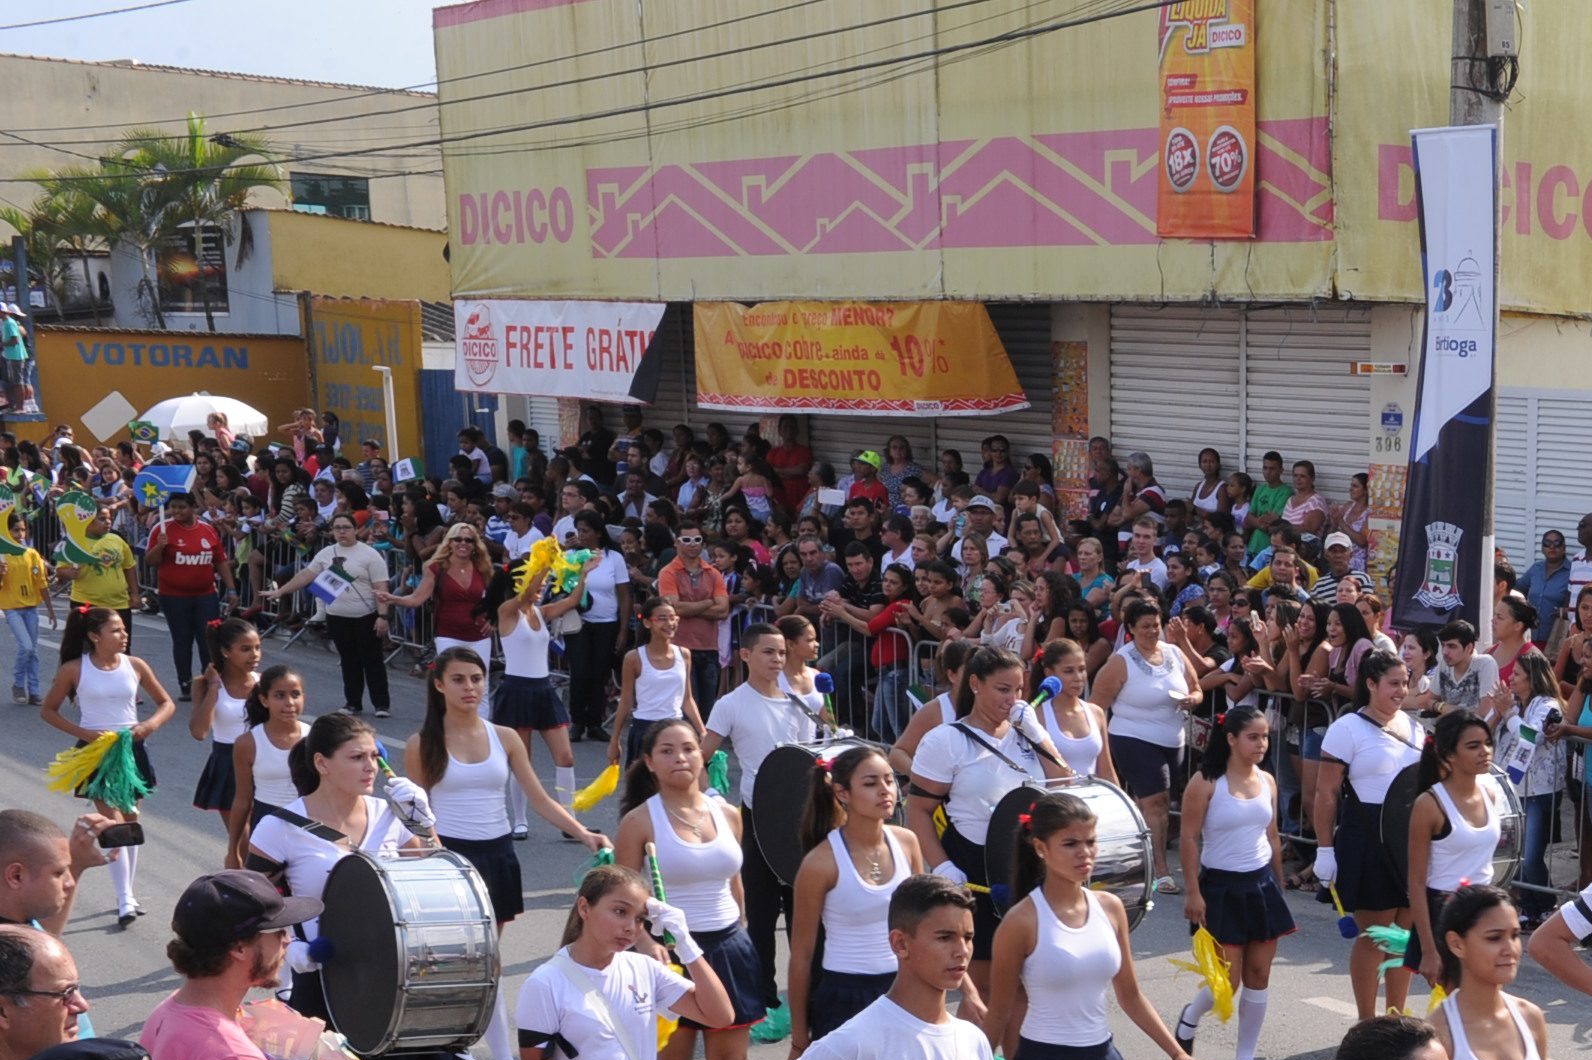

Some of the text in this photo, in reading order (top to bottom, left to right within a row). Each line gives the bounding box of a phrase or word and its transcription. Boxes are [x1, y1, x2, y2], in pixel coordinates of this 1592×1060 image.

[1211, 30, 1242, 43] DICICO
[1211, 148, 1242, 178] 70%
[460, 187, 574, 246] DICICO
[831, 306, 896, 328] MENOR?
[76, 341, 249, 370] VOTORAN
[463, 342, 497, 359] DICICO
[505, 317, 656, 374] FRETE GRÁTI
[724, 330, 735, 345] A
[832, 344, 870, 361] ainda
[784, 368, 882, 392] DESCONTO
[1375, 437, 1402, 453] 396
